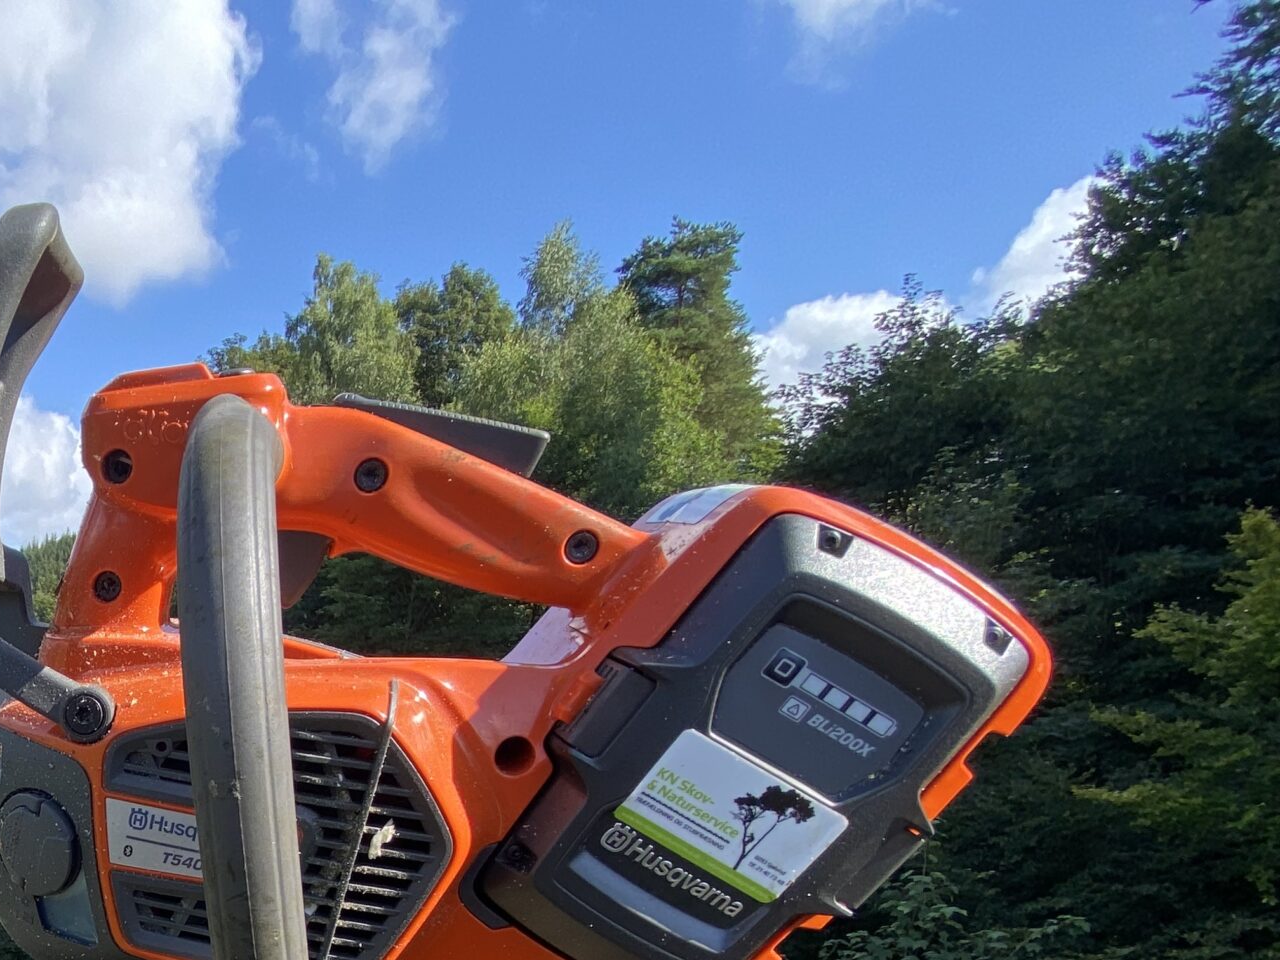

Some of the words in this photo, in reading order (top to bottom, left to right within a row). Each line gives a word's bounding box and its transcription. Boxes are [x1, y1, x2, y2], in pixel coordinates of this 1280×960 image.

[806, 713, 876, 758] BLi200X
[646, 779, 658, 792] &
[656, 785, 739, 839] Naturservice
[656, 767, 680, 786] KN
[677, 779, 715, 805] Skov-
[624, 837, 744, 918] Husqvarna
